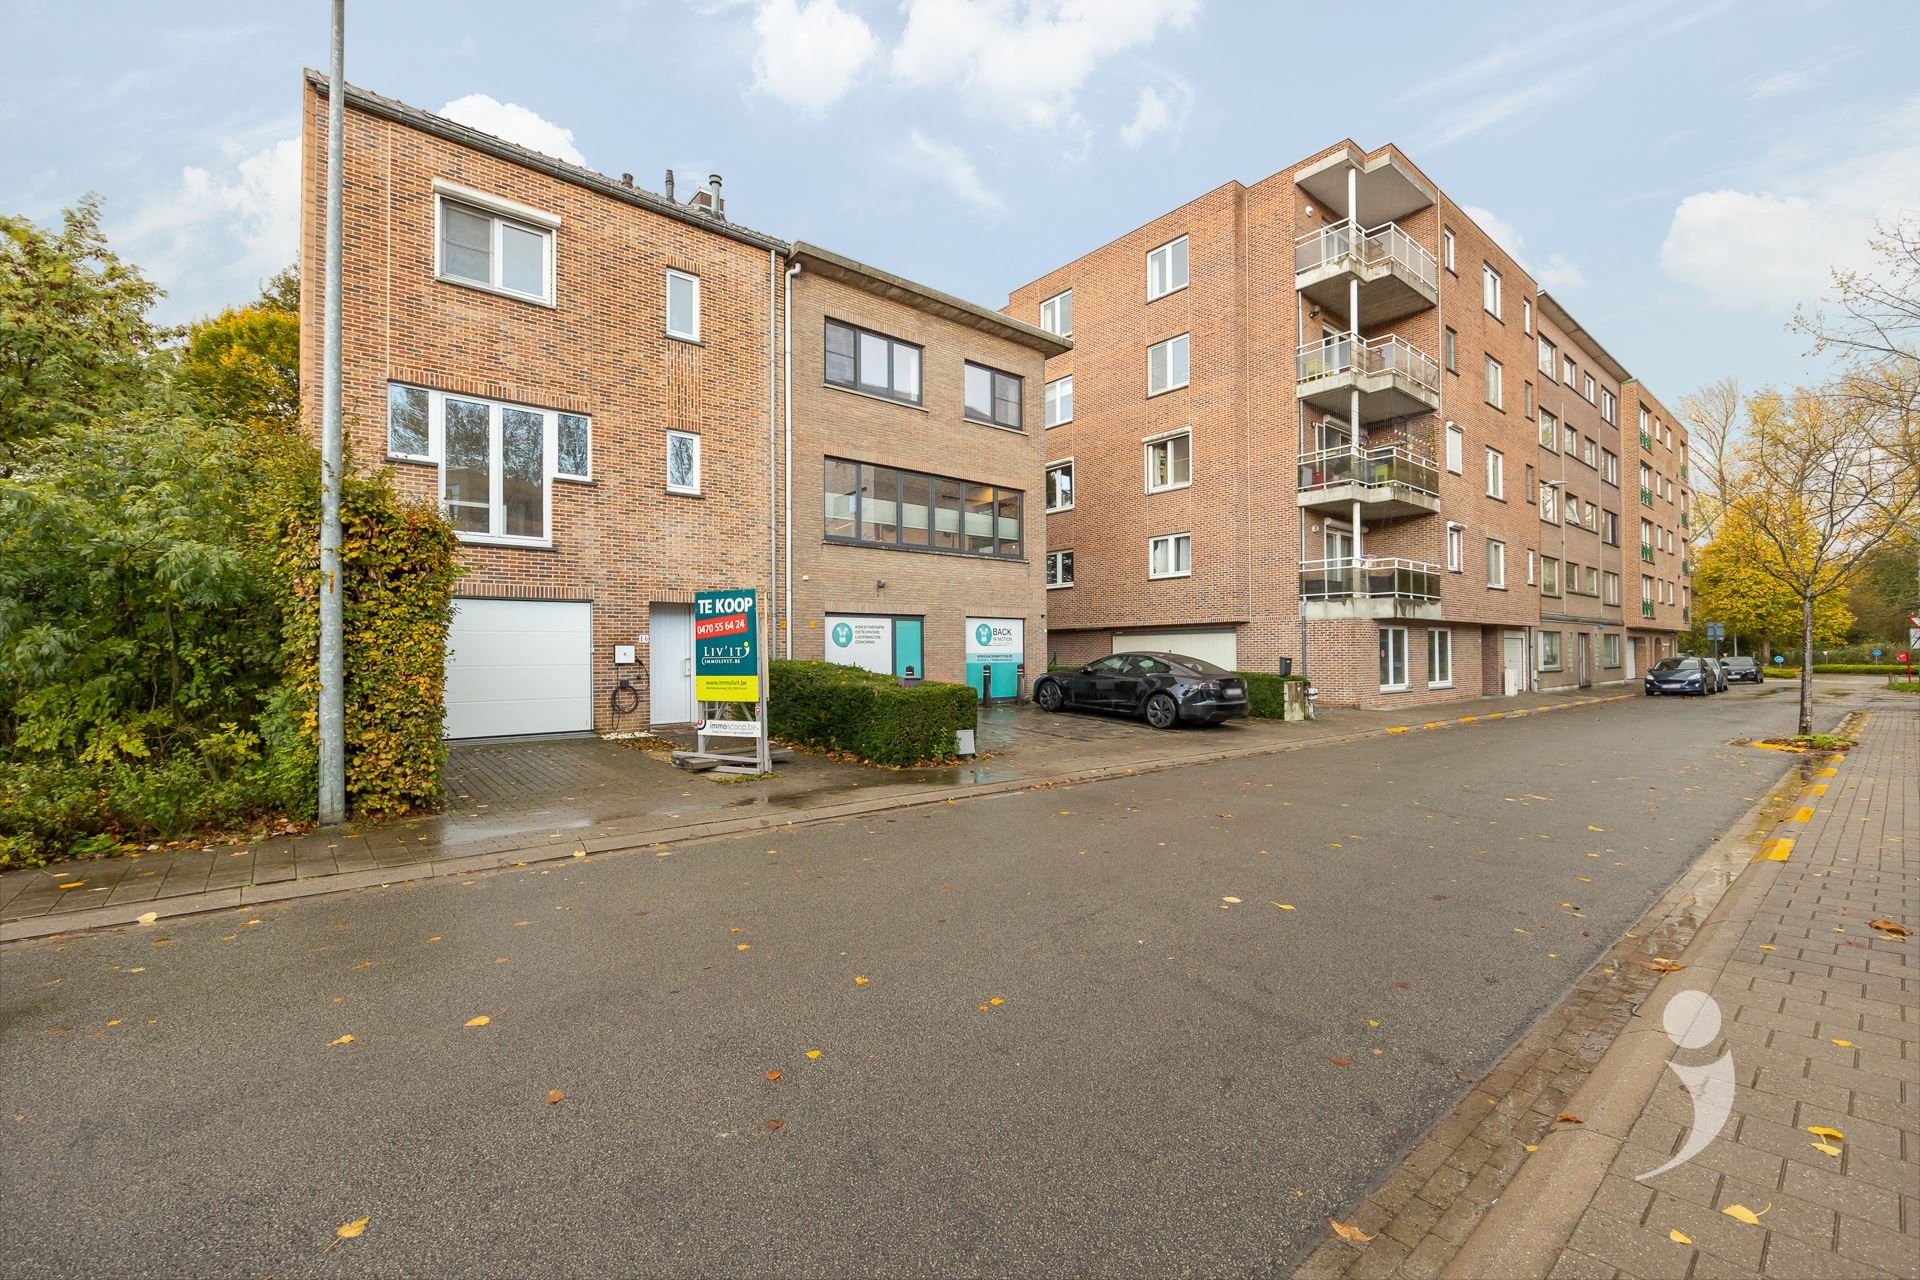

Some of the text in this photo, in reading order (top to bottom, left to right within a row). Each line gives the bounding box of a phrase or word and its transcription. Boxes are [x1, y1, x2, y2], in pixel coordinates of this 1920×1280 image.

[697, 597, 753, 614] TE KOOP
[697, 619, 745, 635] 0470 55 64 24
[992, 627, 1012, 636] BACK
[709, 722, 757, 732] immoscoop.be
